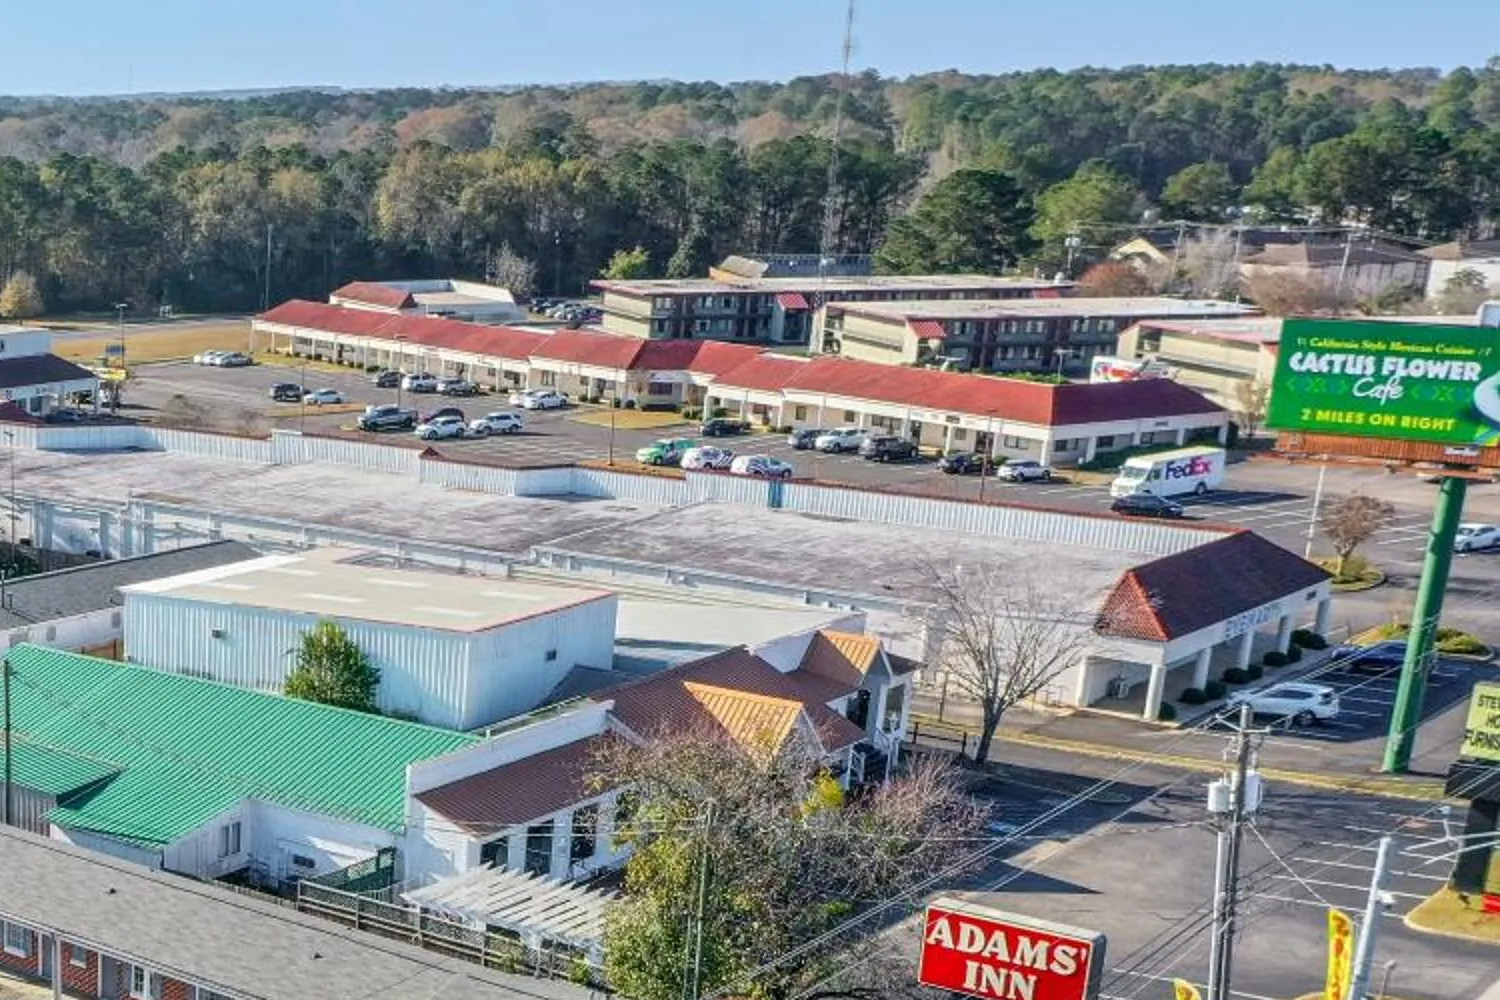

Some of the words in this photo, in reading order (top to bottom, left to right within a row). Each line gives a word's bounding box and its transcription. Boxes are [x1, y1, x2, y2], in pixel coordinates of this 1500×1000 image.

[1289, 351, 1376, 376] CACTUS
[1380, 356, 1483, 381] FLOWER
[1300, 409, 1311, 421] 2
[1315, 410, 1365, 424] MILES
[1369, 412, 1396, 427] ON
[1401, 414, 1456, 431] RIGHT
[1166, 456, 1212, 480] FedEx
[926, 917, 1087, 977] ADAMS'
